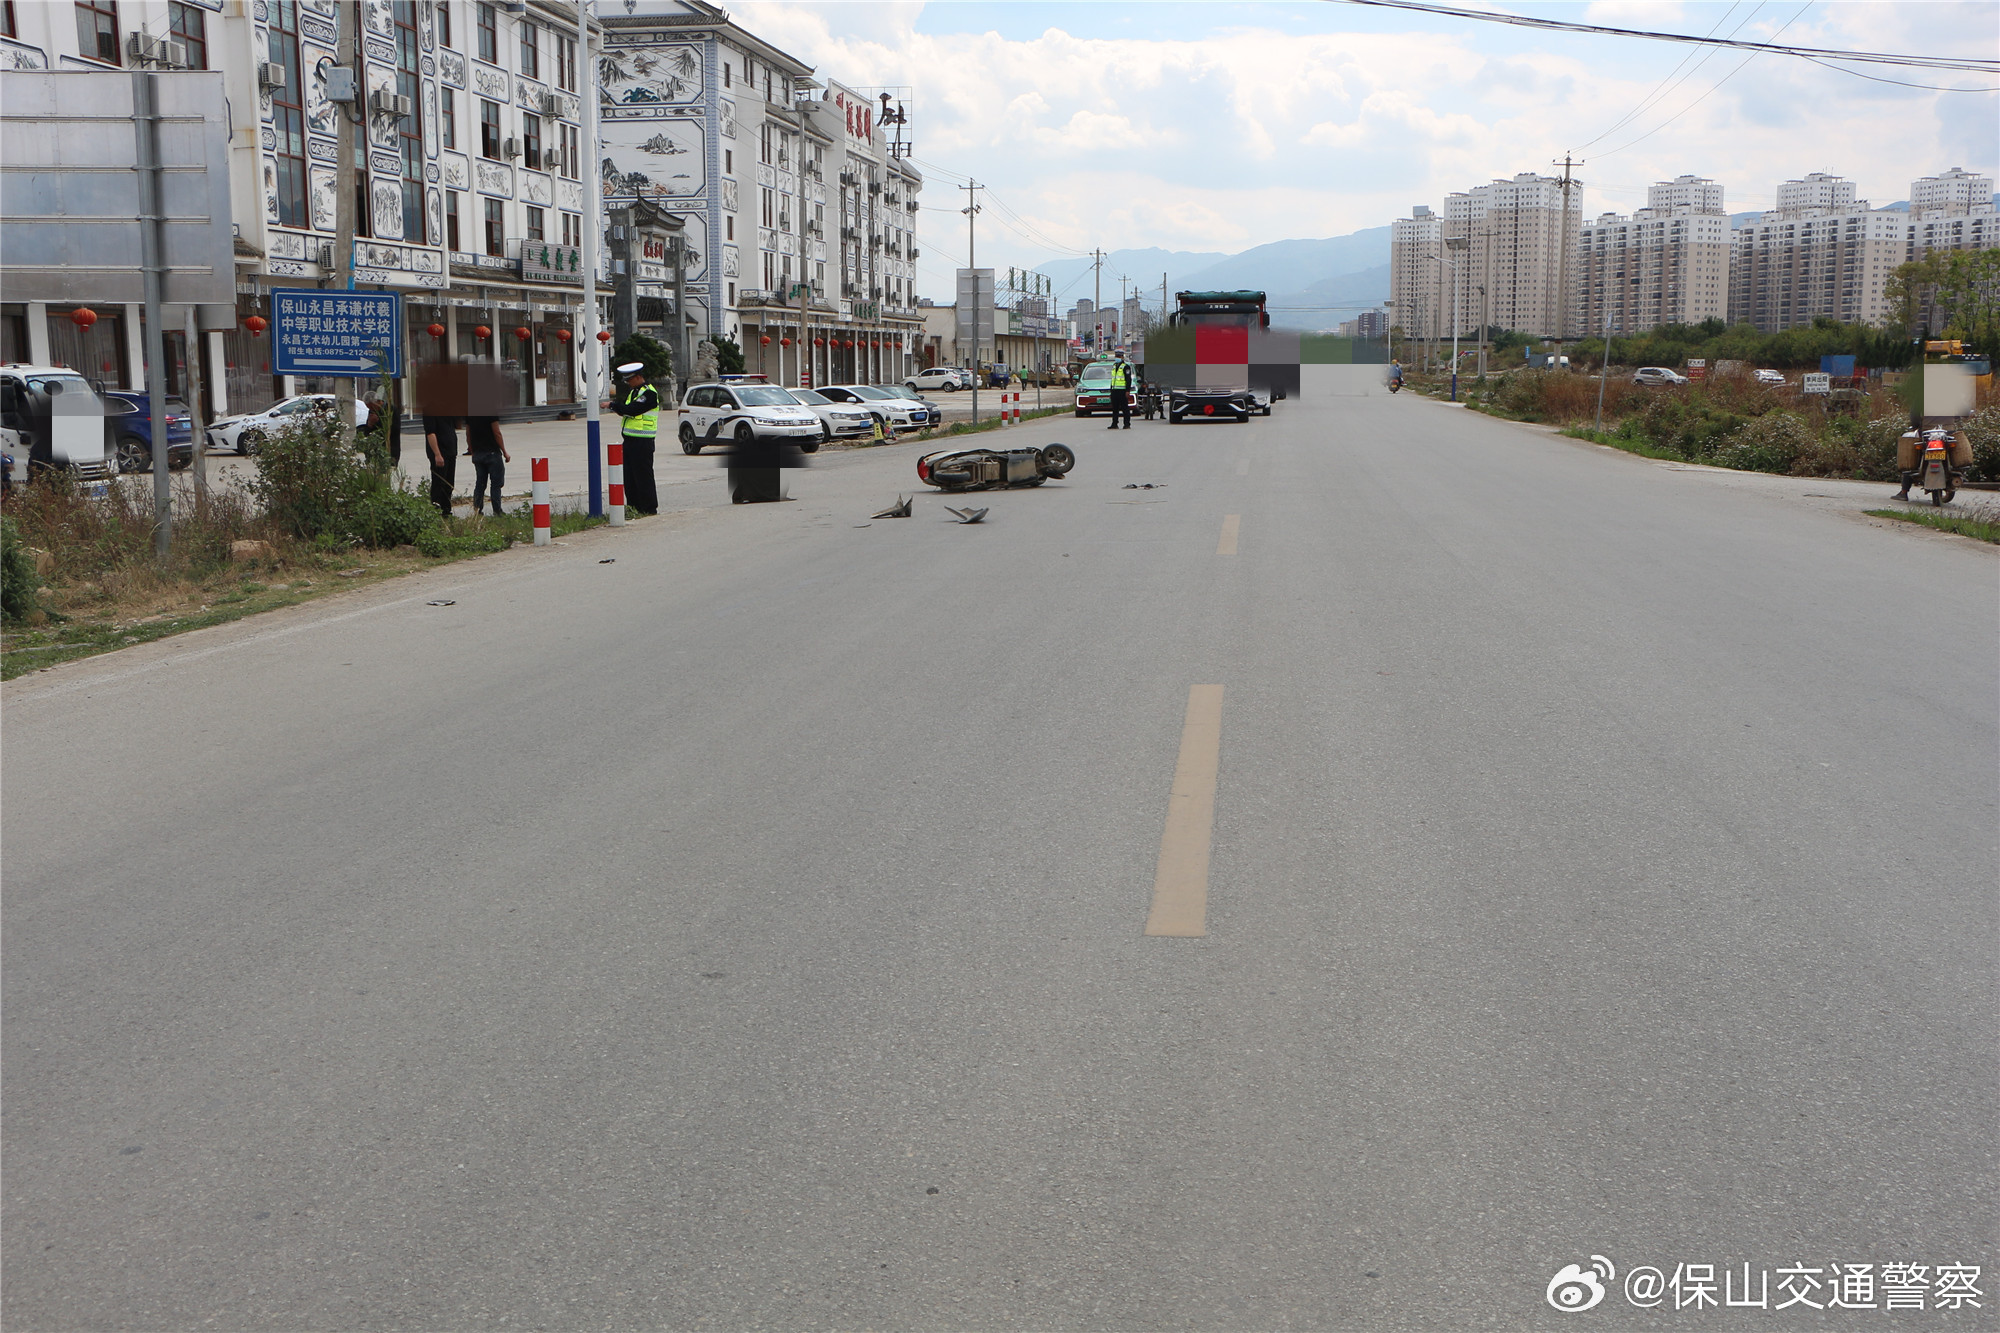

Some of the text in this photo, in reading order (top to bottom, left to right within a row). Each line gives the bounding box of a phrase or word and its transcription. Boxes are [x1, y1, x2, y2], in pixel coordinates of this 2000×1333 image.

[281, 299, 391, 318] 保山永昌承谦伏羲
[281, 316, 391, 335] 中等职业技术学校
[281, 333, 391, 348] 永昌艺术幼儿园第一分园
[696, 416, 706, 427] 公安
